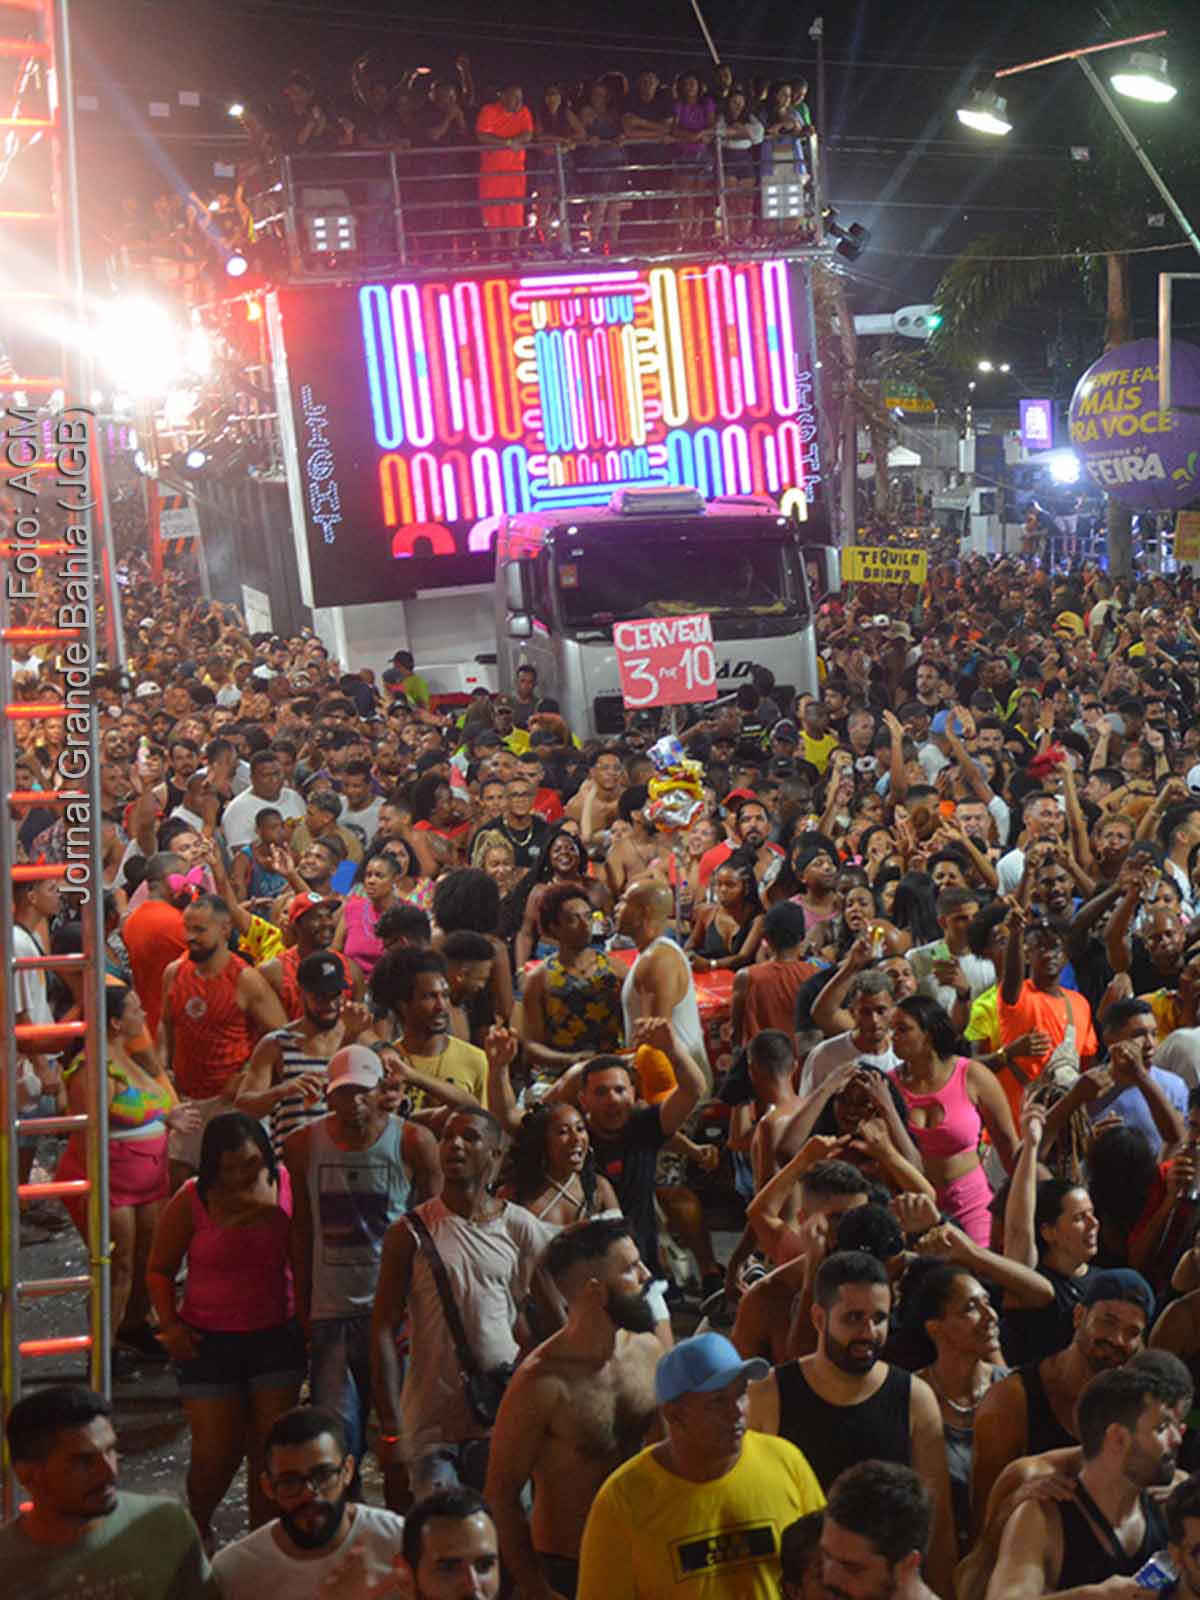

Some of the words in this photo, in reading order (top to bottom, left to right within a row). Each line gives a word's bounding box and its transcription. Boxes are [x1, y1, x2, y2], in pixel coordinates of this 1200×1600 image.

[1078, 387, 1142, 417] MAIS
[1087, 453, 1167, 485] FEIRA
[624, 658, 659, 704] 3
[679, 645, 716, 690] 10
